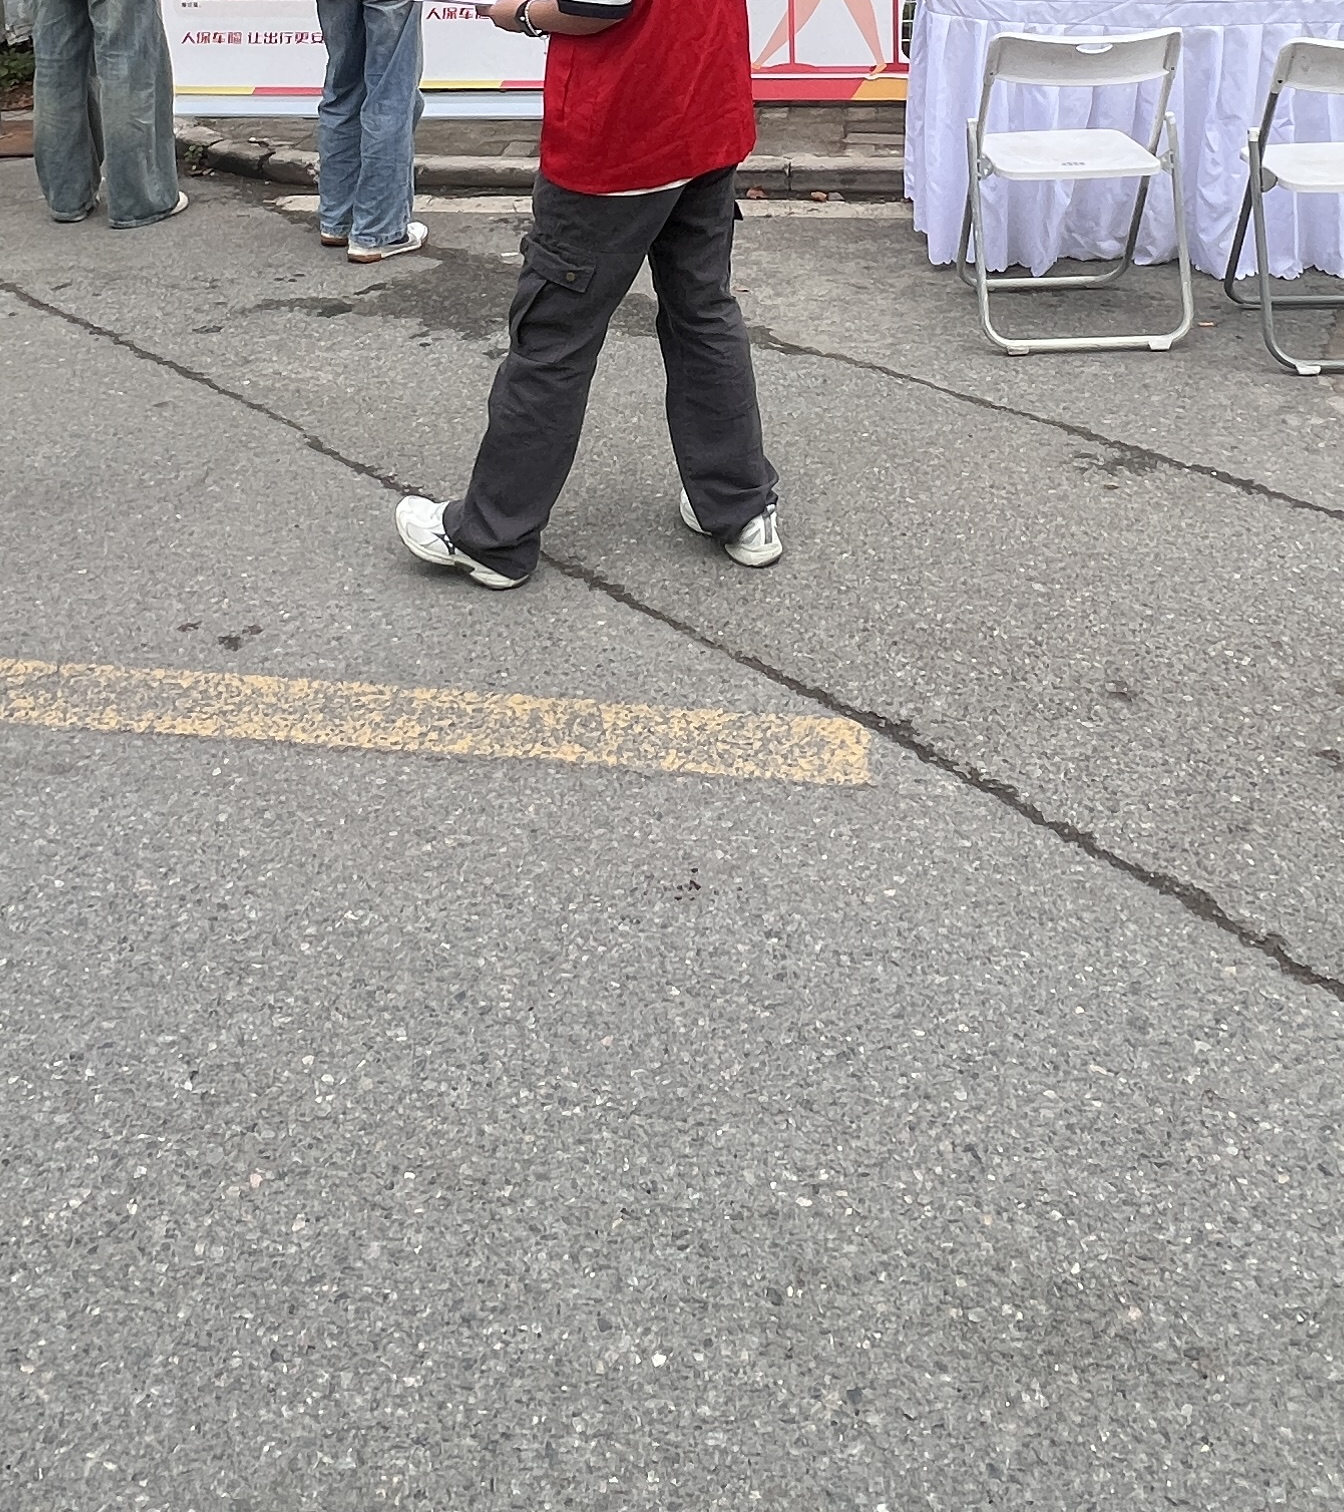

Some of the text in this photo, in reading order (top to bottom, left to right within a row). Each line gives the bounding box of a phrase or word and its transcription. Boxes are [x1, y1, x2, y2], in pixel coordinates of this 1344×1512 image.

[426, 7, 490, 21] 人保车
[181, 31, 243, 45] 人保车险
